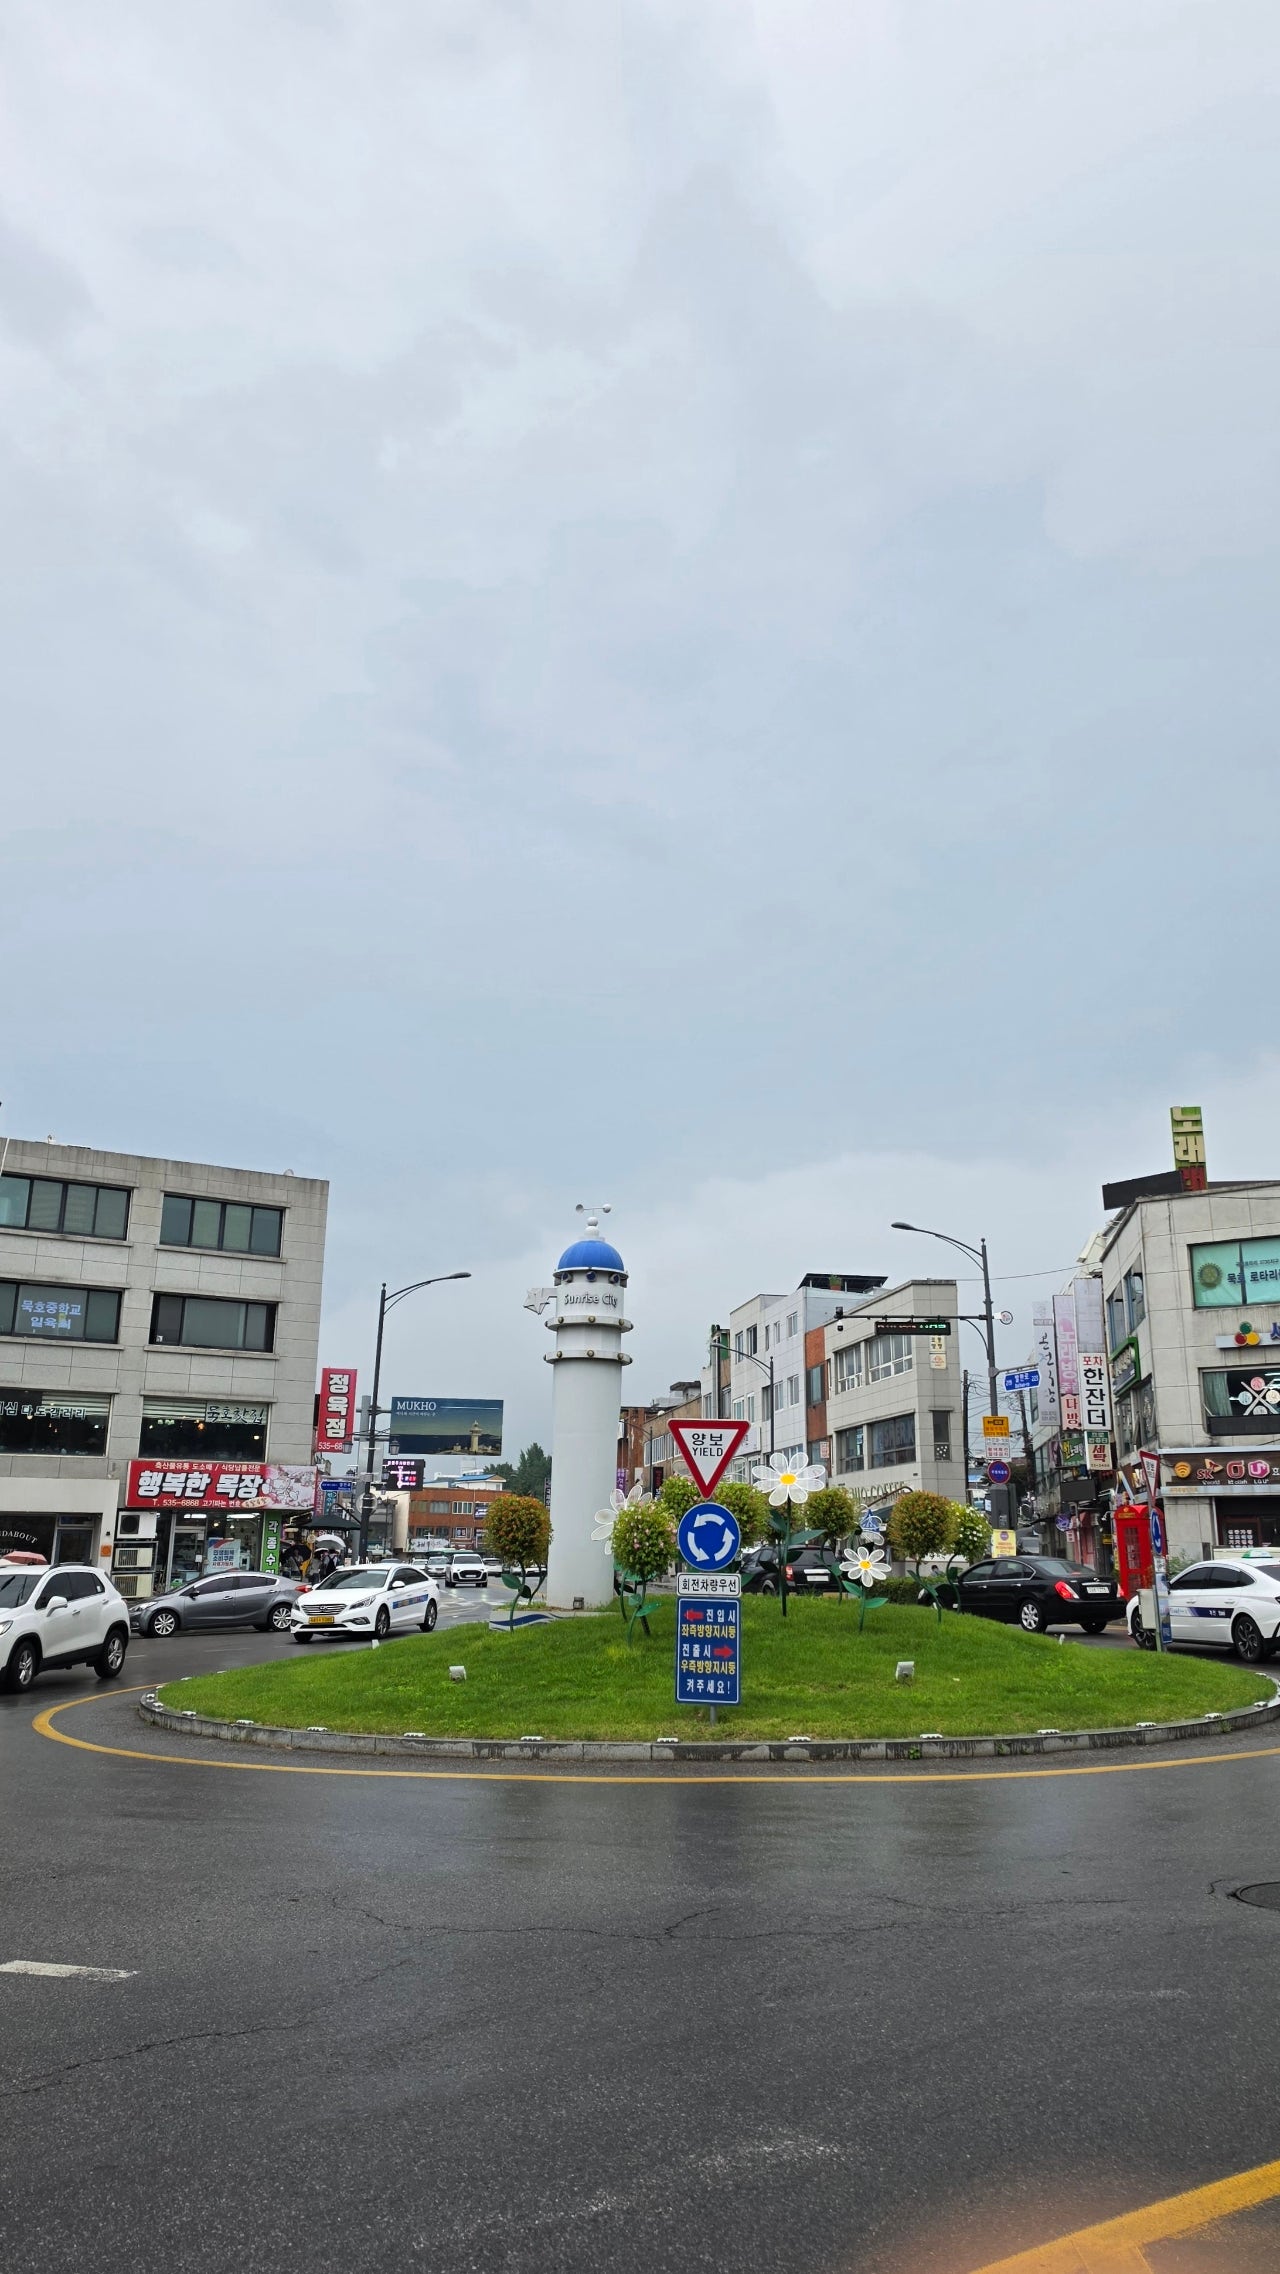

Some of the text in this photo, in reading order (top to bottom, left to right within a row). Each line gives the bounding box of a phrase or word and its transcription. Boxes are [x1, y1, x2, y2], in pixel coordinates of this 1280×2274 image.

[1250, 1268, 1280, 1283] 로타리
[21, 1300, 81, 1316] 묵호중학교
[564, 1294, 618, 1308] Sunrise City
[1083, 1356, 1102, 1367] 포차
[1083, 1367, 1107, 1427] 한잔더
[325, 1373, 350, 1439] 정육점
[396, 1401, 437, 1411] MUKHO
[1065, 1398, 1080, 1425] 다방
[691, 1432, 723, 1446] 양보
[692, 1447, 723, 1457] YIELD
[1197, 1468, 1214, 1480] SK
[138, 1470, 263, 1499] 행복한 목장
[0, 1530, 38, 1544] DABOUT
[681, 1578, 737, 1593] 회전차량우선
[681, 1623, 737, 1639] 좌측방향지시등
[680, 1659, 736, 1675] 우측방향지시등
[686, 1678, 731, 1694] 켜주세요!
